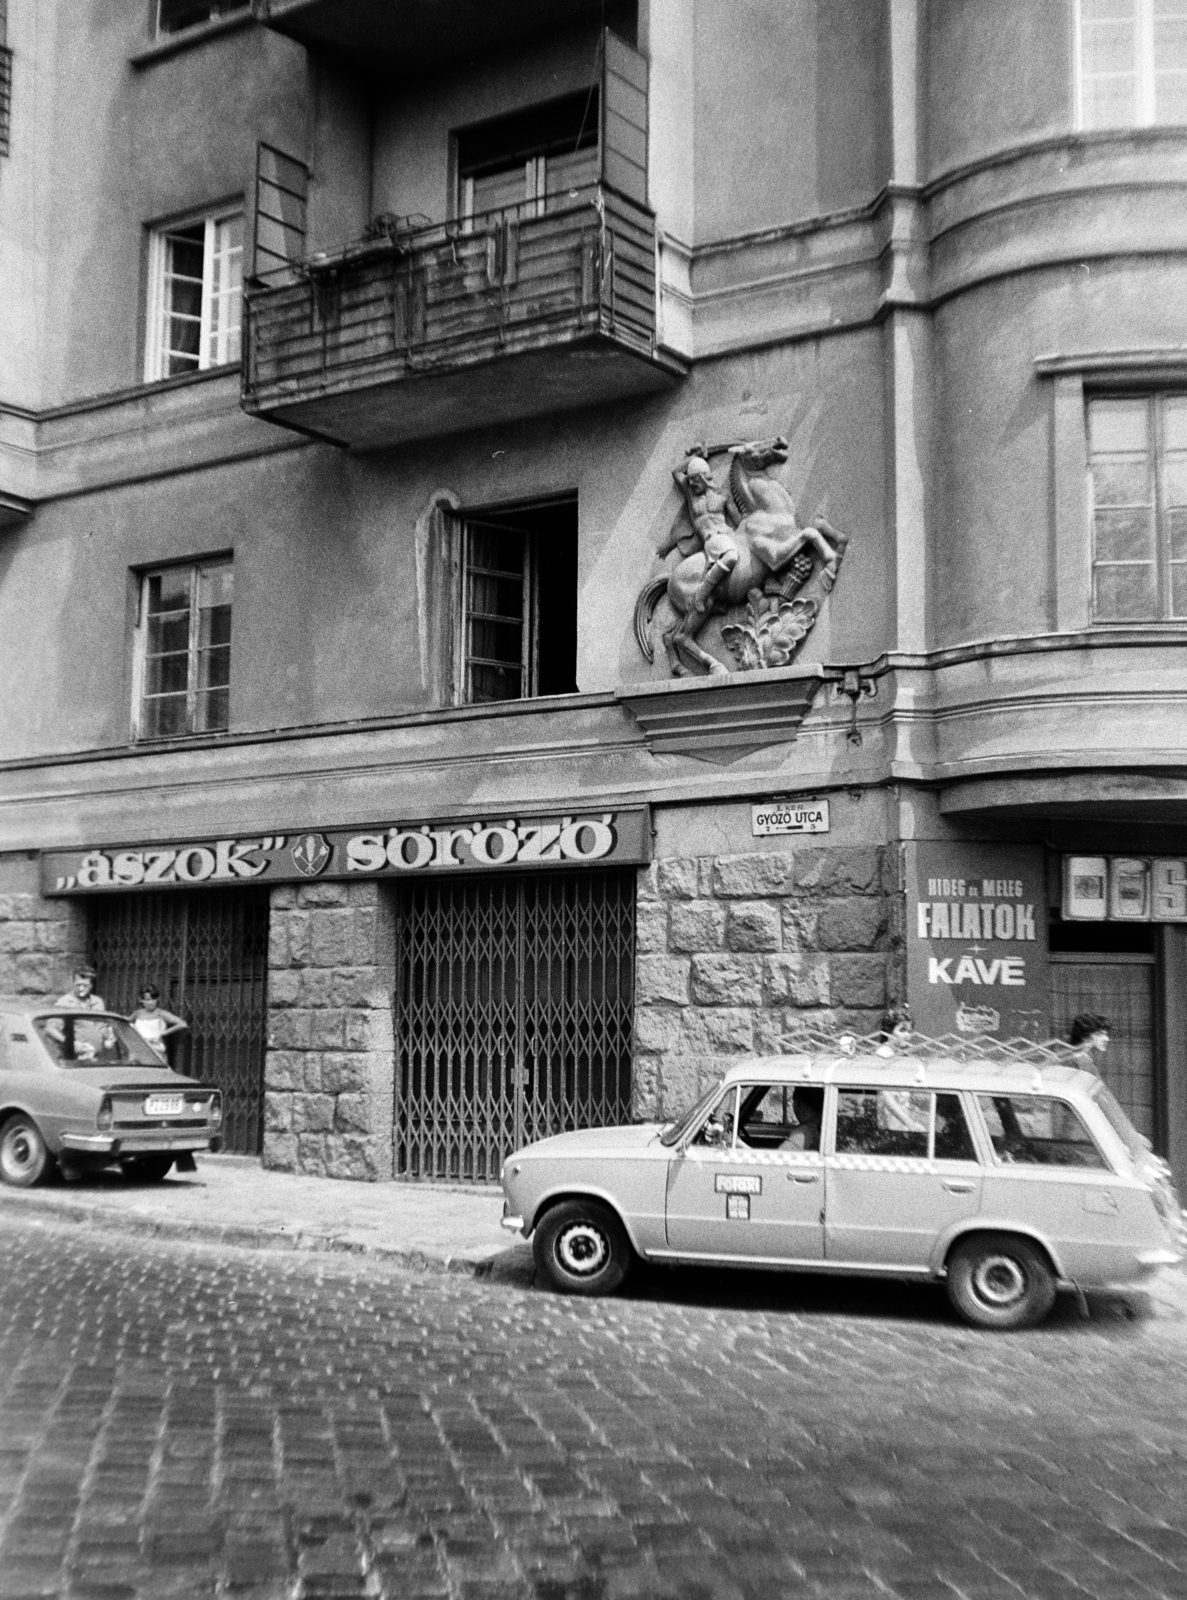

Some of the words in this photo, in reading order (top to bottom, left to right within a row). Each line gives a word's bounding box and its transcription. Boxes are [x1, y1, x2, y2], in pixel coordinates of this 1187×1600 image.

[795, 811, 823, 823] UTCA
[346, 813, 613, 871] söröző
[927, 878, 966, 897] HIDEG
[982, 879, 1023, 898] MELEG
[917, 902, 1037, 940] FALATOK
[928, 955, 1026, 986] KÁVÉ
